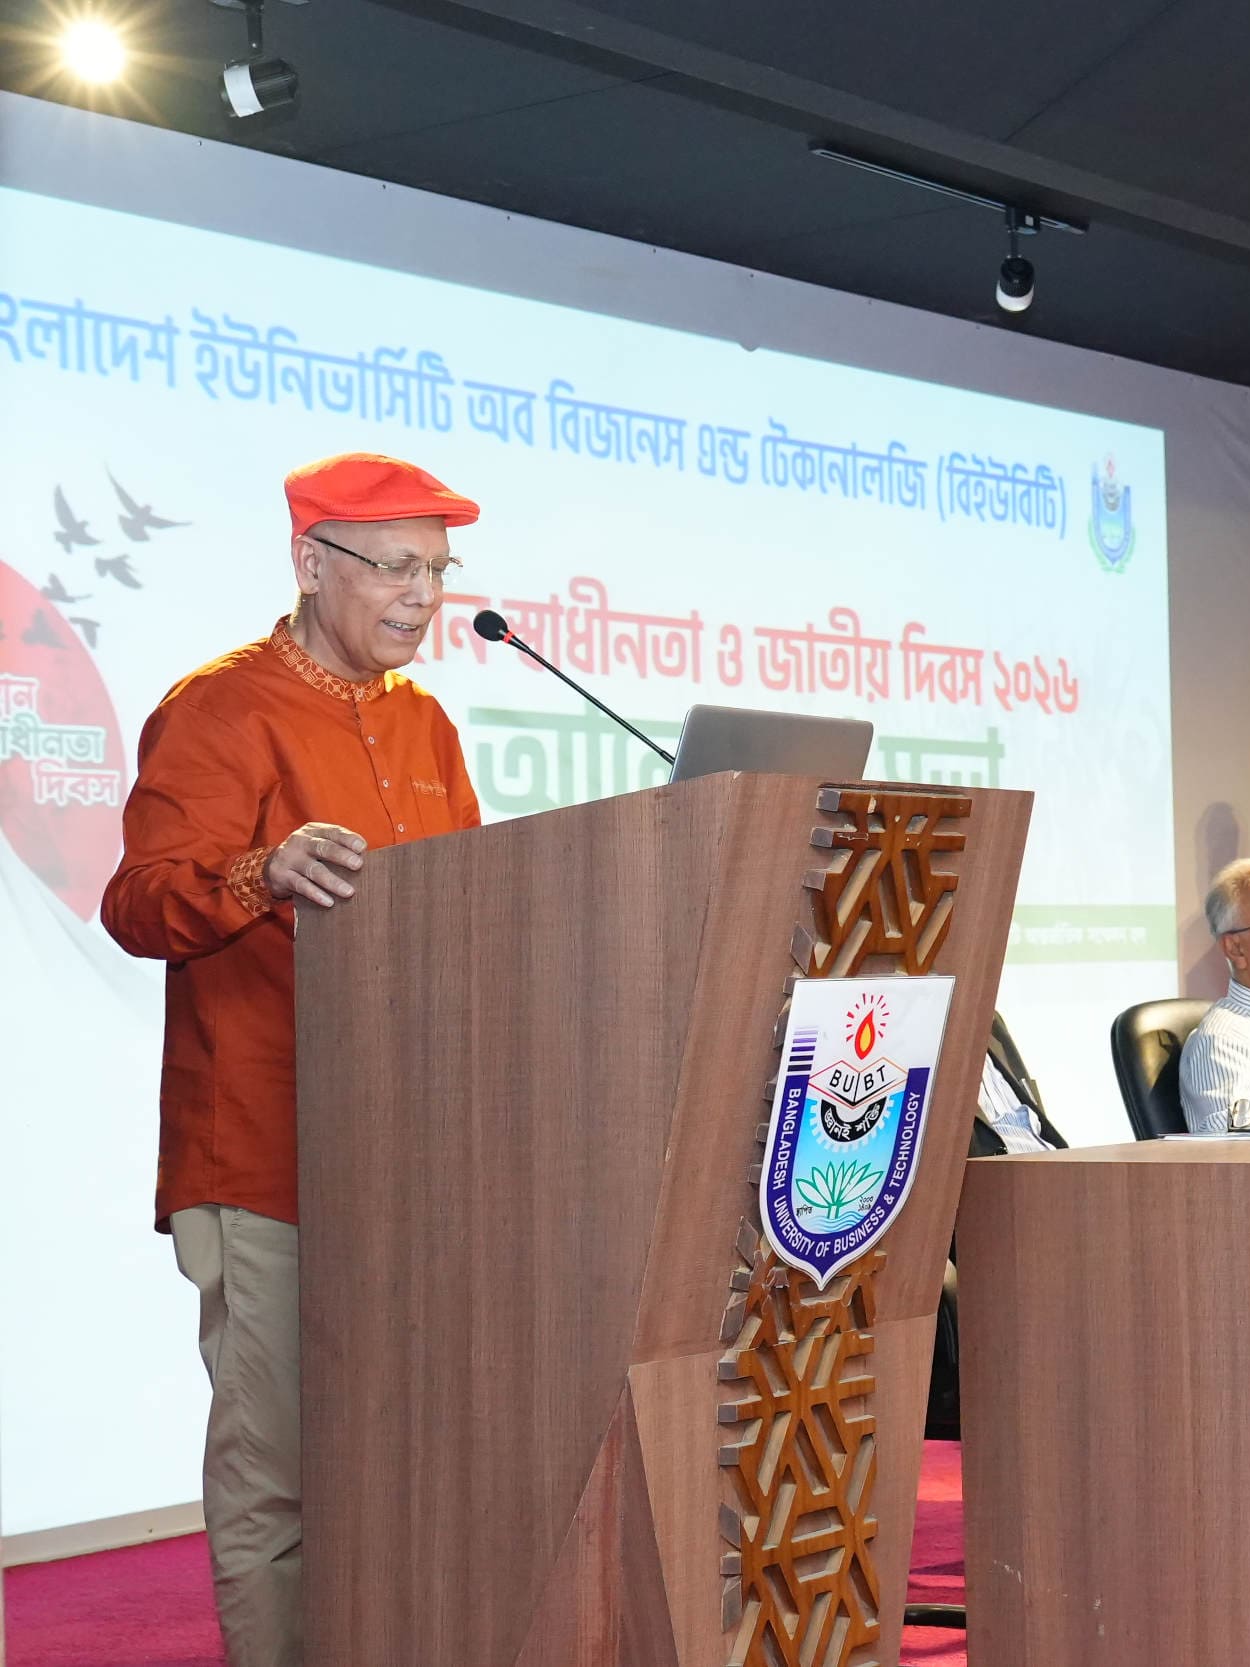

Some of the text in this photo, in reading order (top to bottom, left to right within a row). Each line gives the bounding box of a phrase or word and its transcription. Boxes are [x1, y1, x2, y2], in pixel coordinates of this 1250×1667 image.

[190, 307, 454, 433] ইউনিভার্সিটি
[463, 380, 536, 446] অব
[546, 379, 687, 472] বিজনেস
[761, 416, 928, 510] টেকনোলজি
[937, 451, 1067, 539] (বিইউবিটি)
[717, 624, 743, 687] ও
[754, 607, 890, 702] জাতীয়
[900, 622, 983, 706] দিবস
[994, 652, 1079, 715] ২০২৬
[35, 758, 119, 806] দিবস
[773, 1088, 921, 1257] BANGLADESH UNIVERSITY OF BUSINESS & TECHNOLOGY
